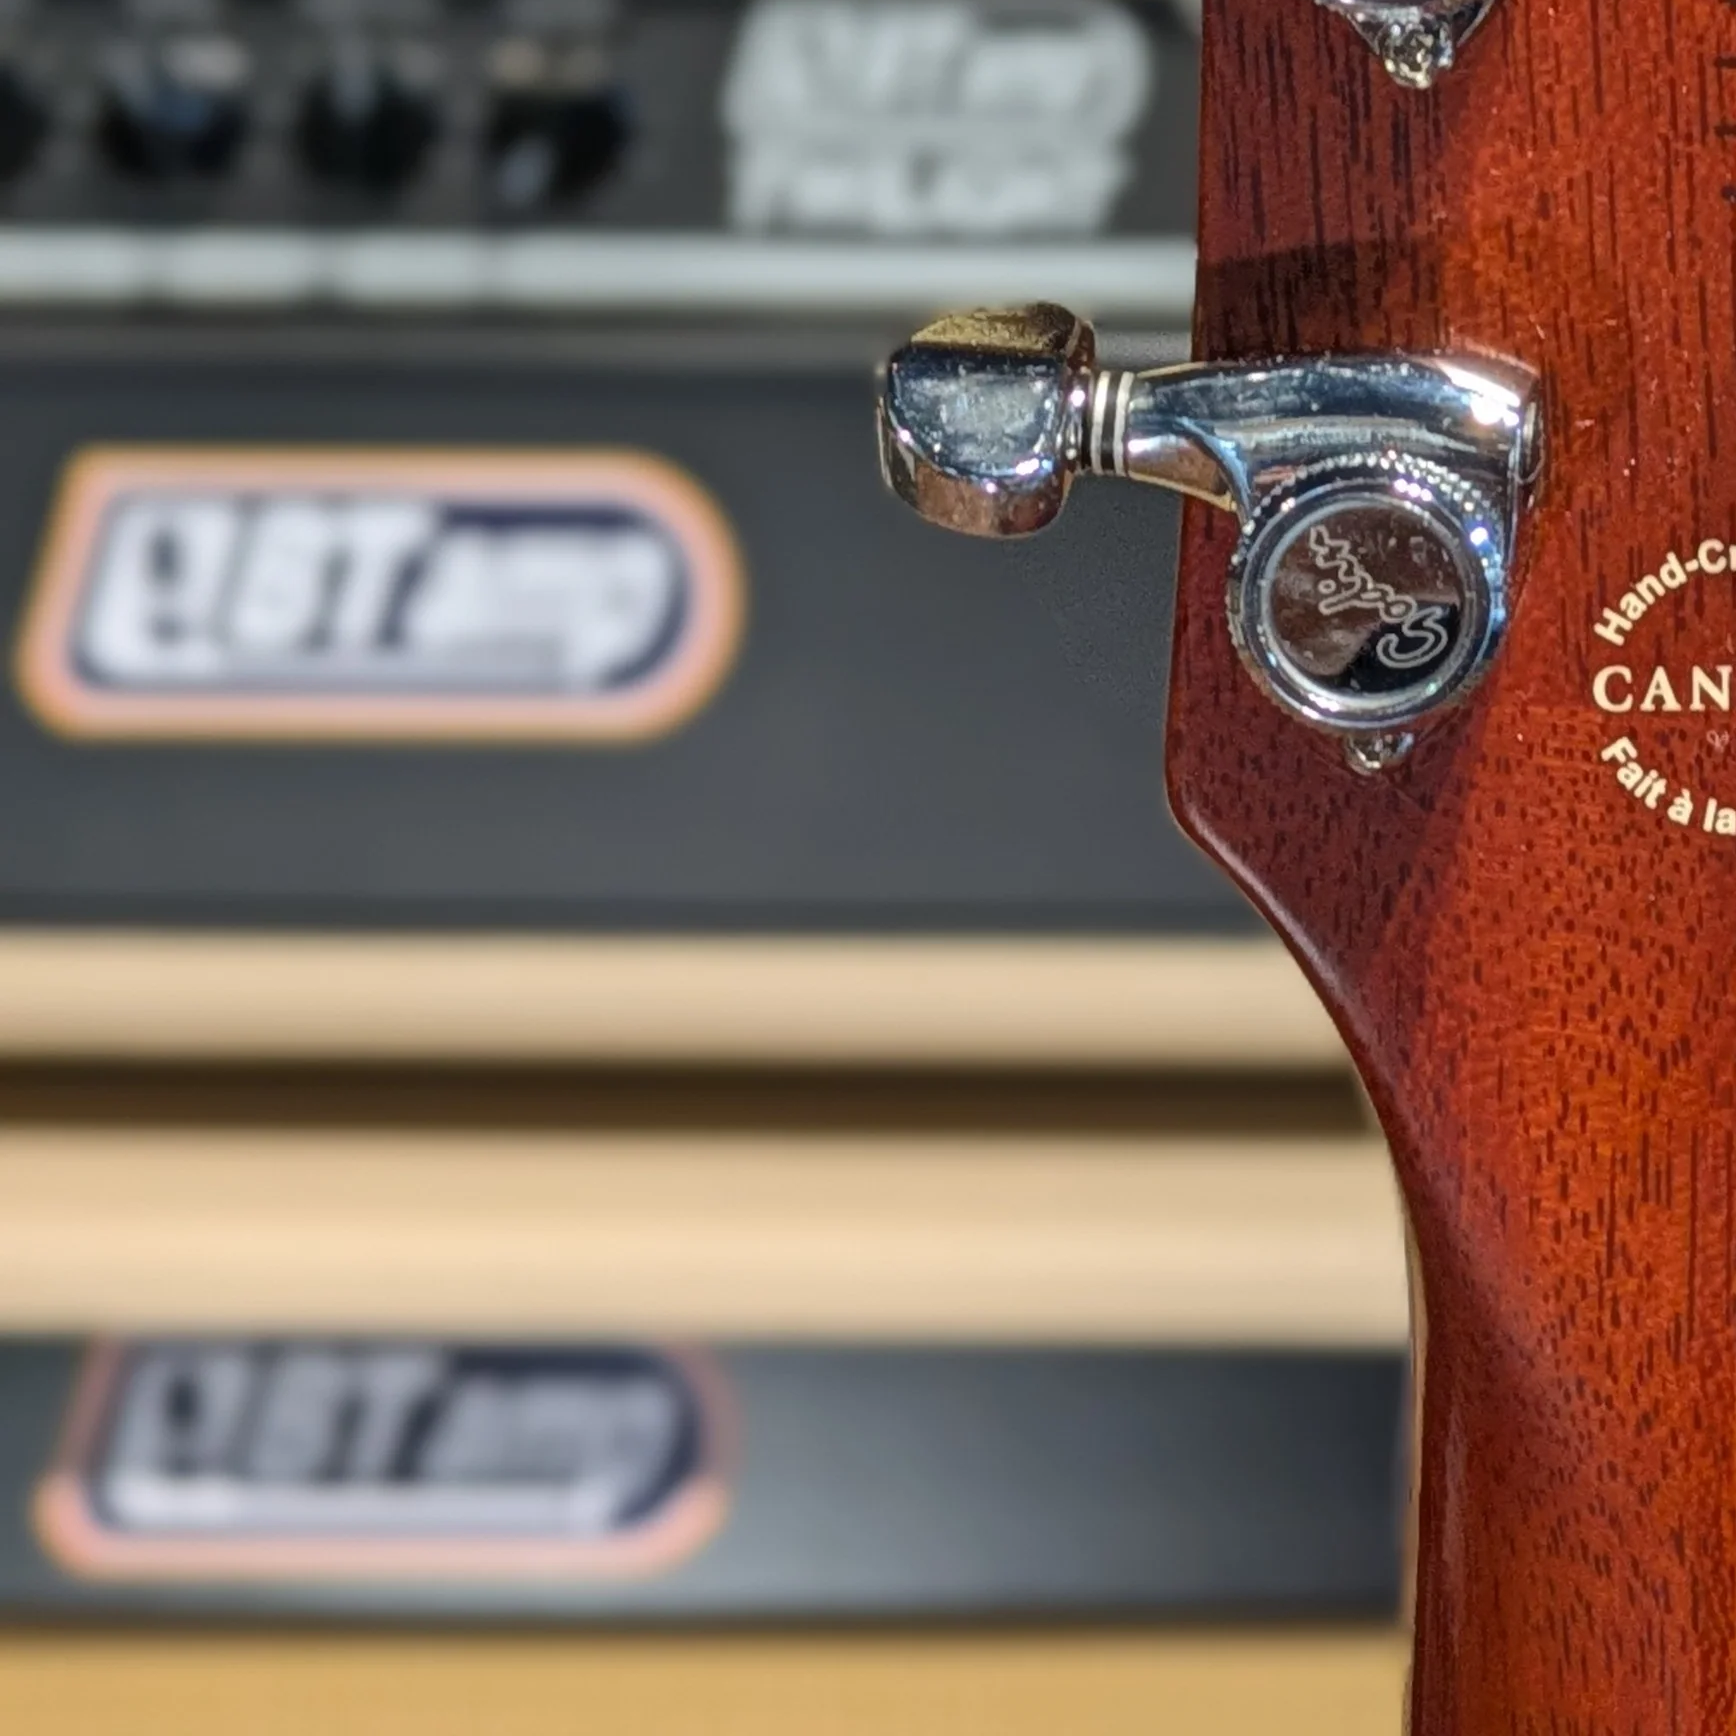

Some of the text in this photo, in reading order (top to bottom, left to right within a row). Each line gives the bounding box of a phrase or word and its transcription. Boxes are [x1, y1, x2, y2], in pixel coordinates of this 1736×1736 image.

[1309, 524, 1449, 669] Godin
[1600, 736, 1668, 810] Fait
[1667, 787, 1694, 826] à
